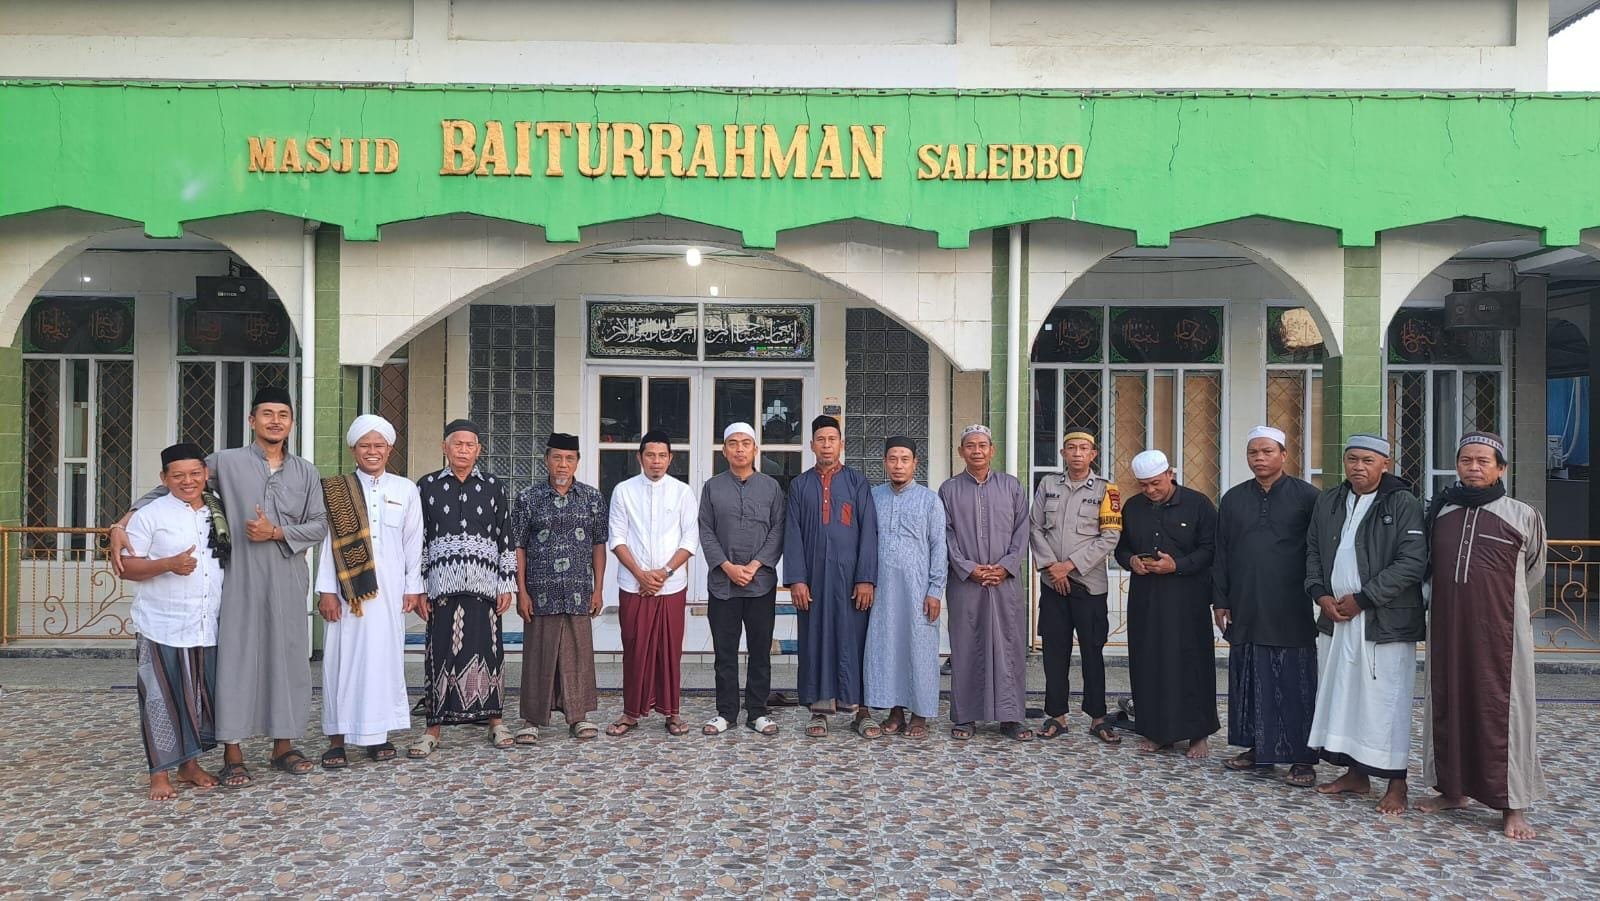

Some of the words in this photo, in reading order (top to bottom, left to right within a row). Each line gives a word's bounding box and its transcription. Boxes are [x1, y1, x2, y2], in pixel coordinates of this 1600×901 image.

[247, 136, 399, 174] MASJID
[440, 119, 887, 181] BAITURRAHMAN
[917, 143, 1084, 181] SALEBBO
